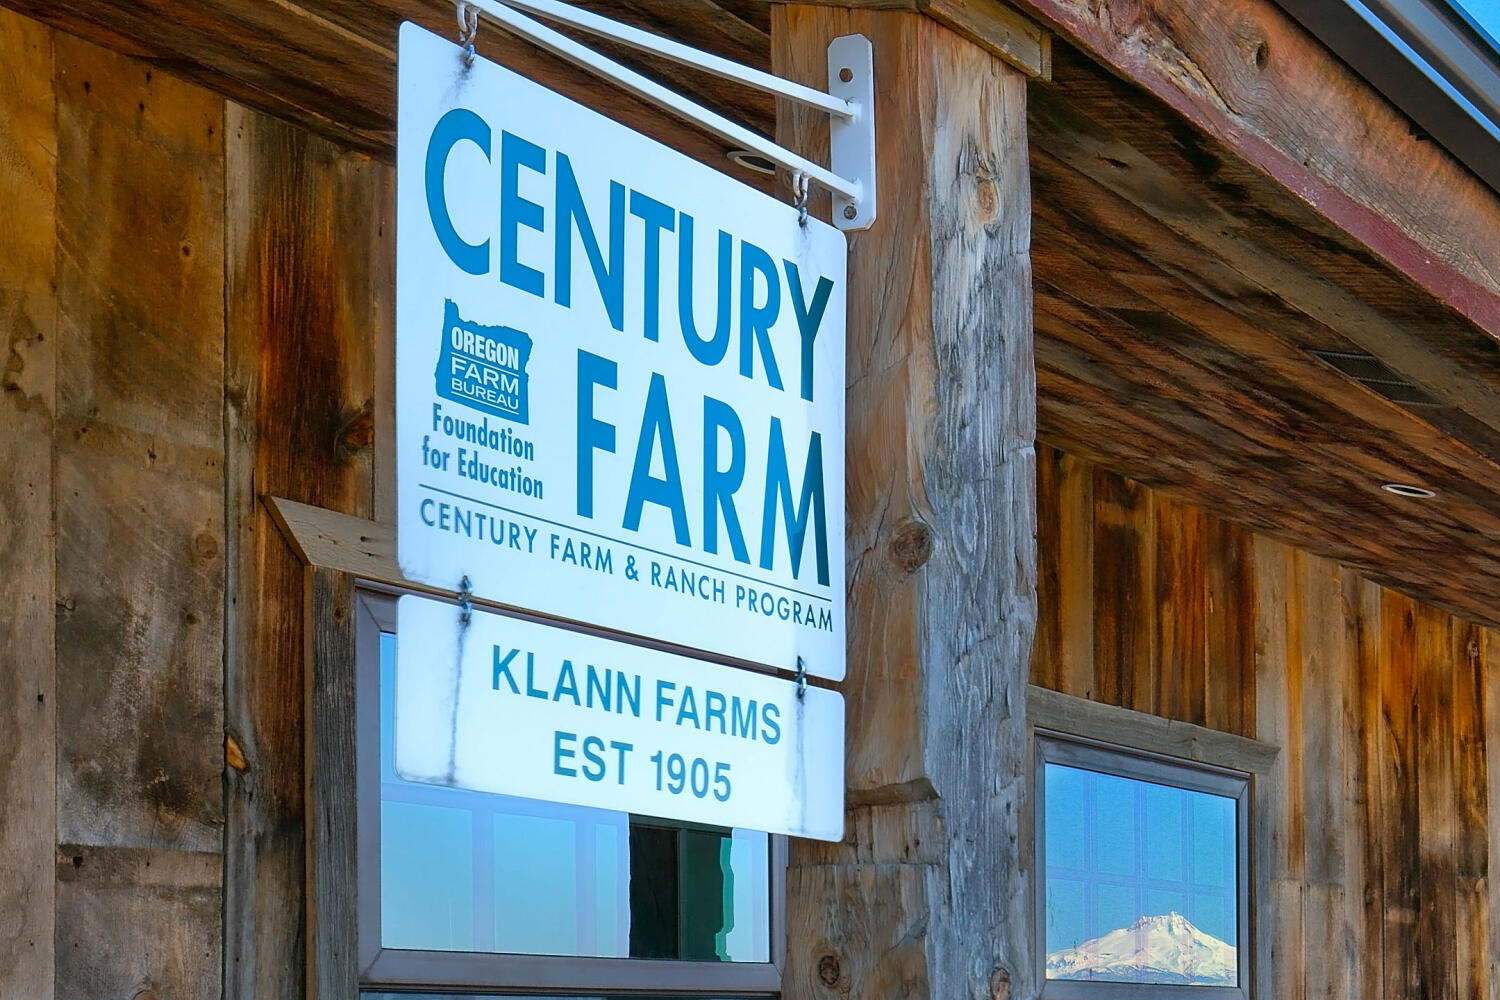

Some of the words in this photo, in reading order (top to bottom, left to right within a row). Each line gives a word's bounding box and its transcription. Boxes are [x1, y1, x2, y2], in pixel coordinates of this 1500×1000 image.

[425, 107, 835, 402] CENTURY
[451, 326, 519, 371] OREGON
[451, 356, 519, 395] FARM
[451, 379, 519, 410] BUREAU
[433, 402, 534, 461] Foundation
[422, 435, 450, 471] for
[458, 447, 543, 500] Education
[576, 349, 832, 588] FARM
[420, 498, 538, 553] CENTURY
[550, 534, 613, 574] FARM
[625, 555, 639, 582] &
[651, 561, 725, 604] RANCH
[736, 585, 833, 632] PROGRAM
[492, 644, 641, 718] KLANN
[656, 679, 781, 745] FARMS
[553, 730, 634, 785] EST
[650, 750, 731, 802] 1905
